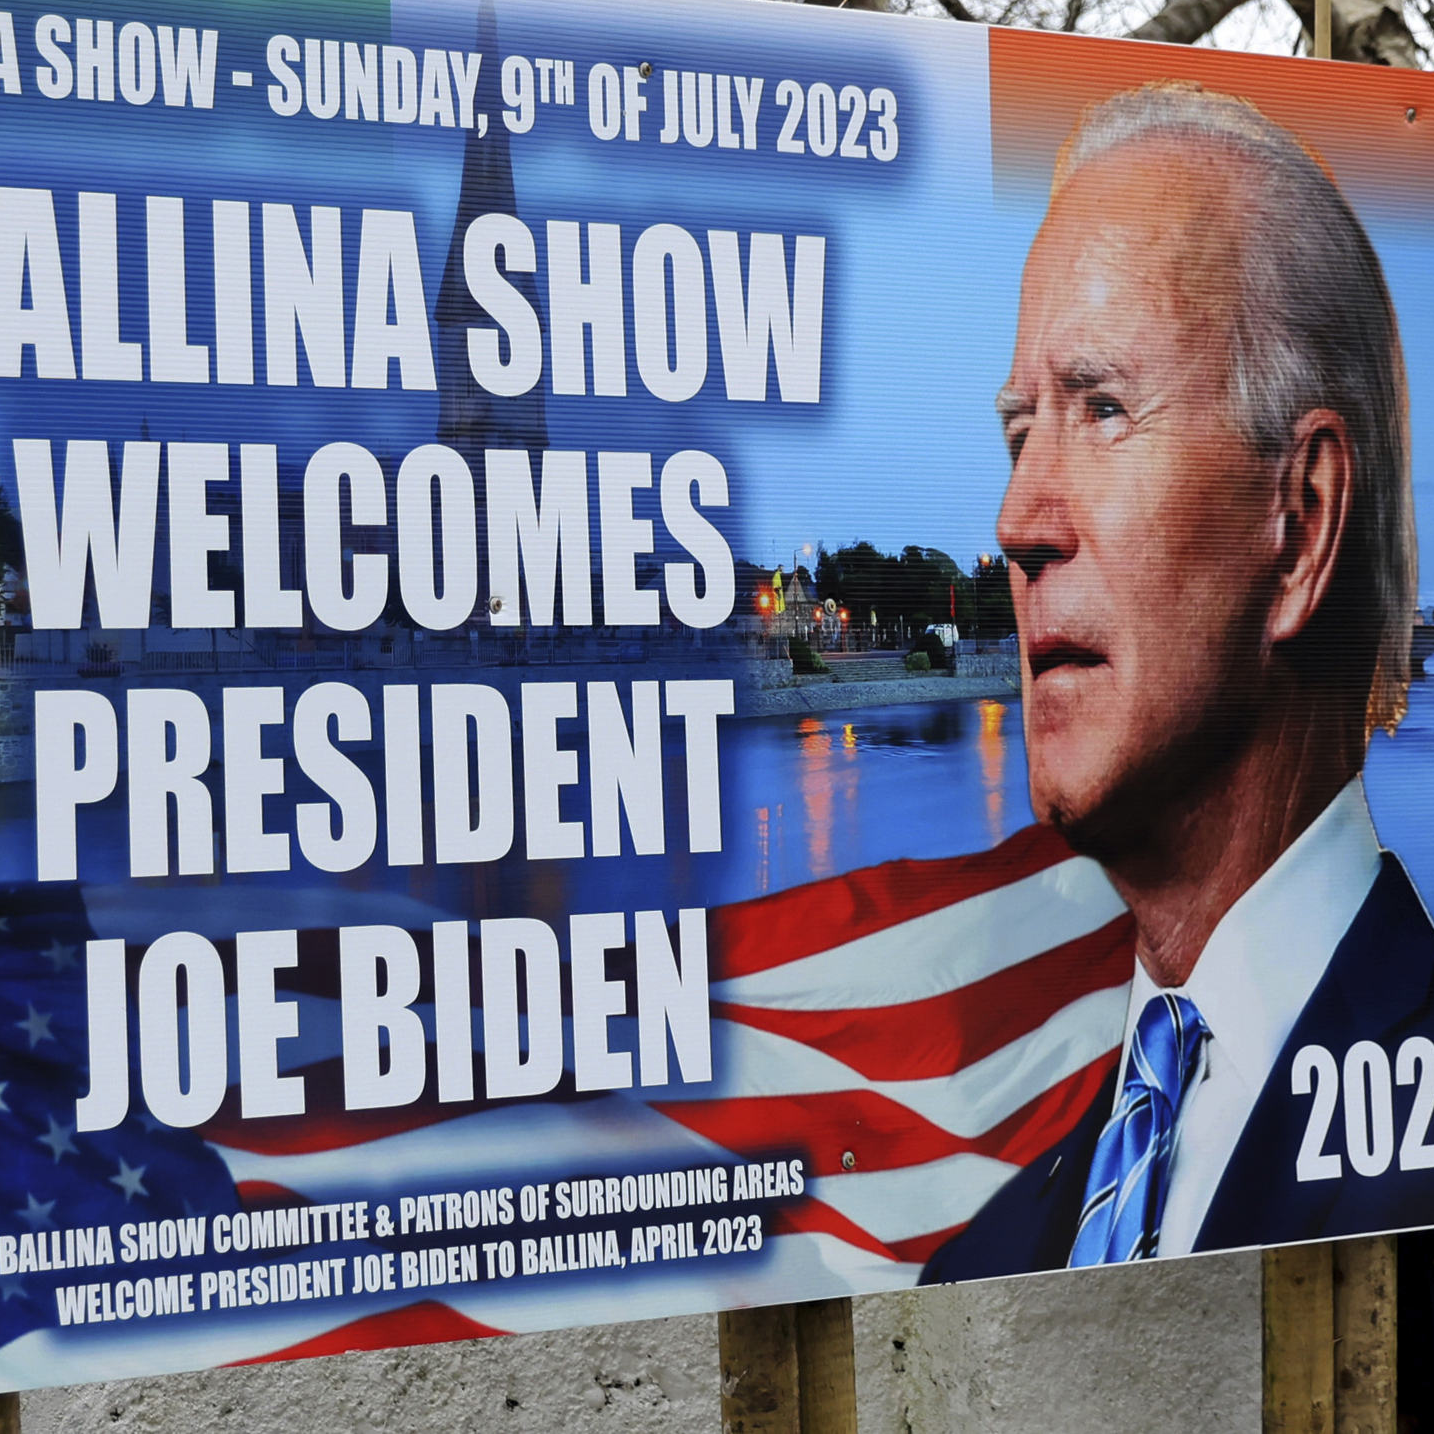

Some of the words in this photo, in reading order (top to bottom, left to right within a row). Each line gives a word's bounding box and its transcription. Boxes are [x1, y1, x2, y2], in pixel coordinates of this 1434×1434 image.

[35, 14, 219, 109] SHOW
[232, 71, 253, 87] -
[266, 34, 489, 139] SUNDAY,
[501, 55, 575, 134] 9TH
[588, 63, 647, 142] OF
[660, 69, 765, 150] JULY
[775, 79, 899, 162] 2023
[463, 212, 826, 404] SHOW
[11, 438, 736, 632] WELCOMES
[34, 679, 735, 882] PRESIDENT
[76, 929, 306, 1133] JOE
[339, 907, 713, 1111] BIDEN
[56, 1274, 195, 1326] WELCOME
[200, 1258, 346, 1310] PRESIDENT
[352, 1253, 396, 1294] JOE
[402, 1244, 478, 1289] BIDEN
[483, 1240, 515, 1279] TO
[521, 1230, 626, 1276] BALLINA,
[630, 1220, 698, 1264] APRIL
[702, 1215, 763, 1256] 2023
[119, 1217, 206, 1263] SHOW
[212, 1201, 369, 1254] COMMITTEE
[375, 1204, 395, 1237] &
[400, 1187, 514, 1234] PATRONS
[520, 1184, 550, 1222] OF
[555, 1166, 728, 1219] SURROUNDING
[733, 1159, 805, 1201] AREAS
